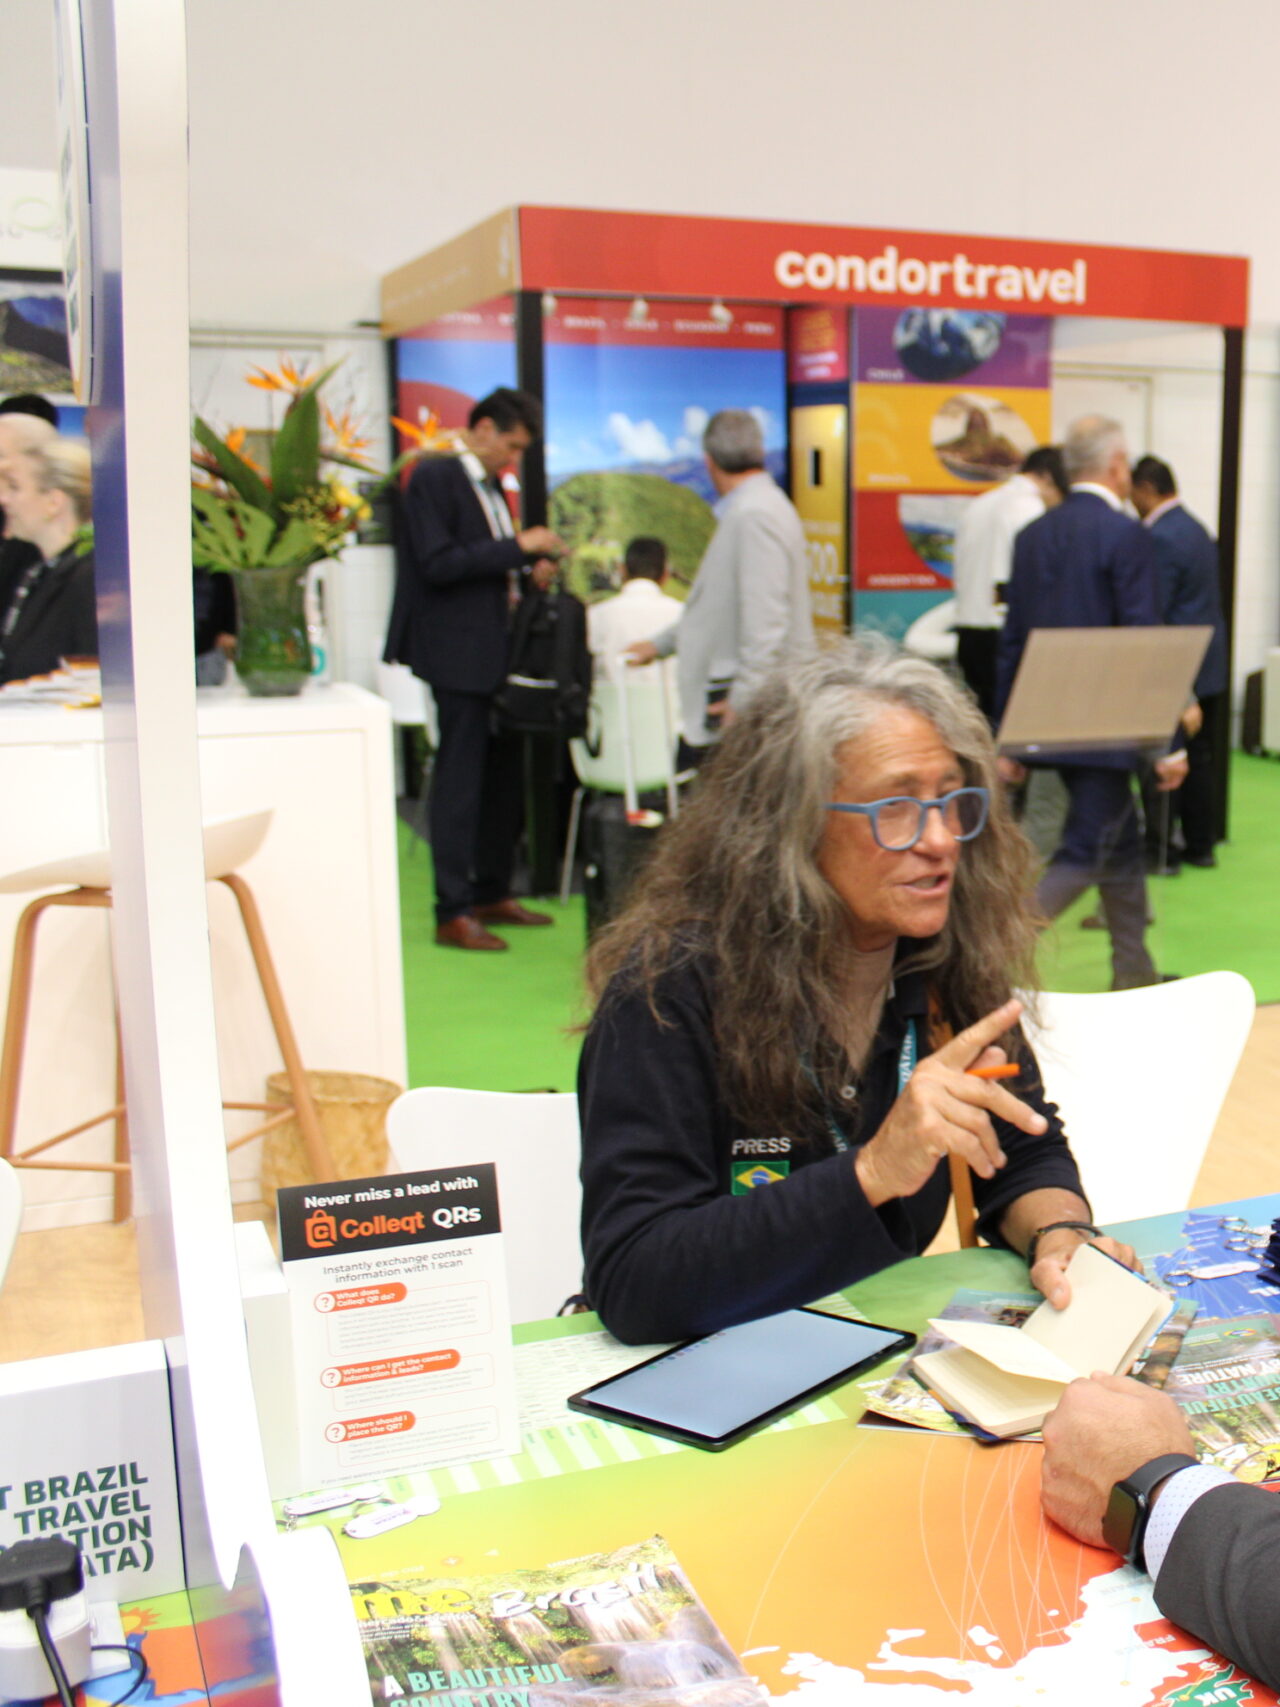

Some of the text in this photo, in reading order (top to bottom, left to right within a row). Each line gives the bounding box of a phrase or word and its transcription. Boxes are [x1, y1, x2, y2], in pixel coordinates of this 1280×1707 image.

[774, 245, 1087, 305] condortravel
[732, 1137, 792, 1155] PRESS
[304, 1176, 478, 1209] Never miss a lead with
[340, 1211, 426, 1239] Colleqt
[432, 1206, 482, 1229] QRs
[323, 1247, 473, 1275] Instantly exchange contact
[335, 1268, 401, 1284] information
[404, 1263, 429, 1275] with
[437, 1258, 464, 1270] scan
[1175, 1363, 1257, 1385] NATURE
[24, 1462, 149, 1505] BRAZIL
[14, 1489, 151, 1535] TRAVEL
[384, 1663, 574, 1698] A BEAUTIFUL
[1194, 1687, 1238, 1706] UK
